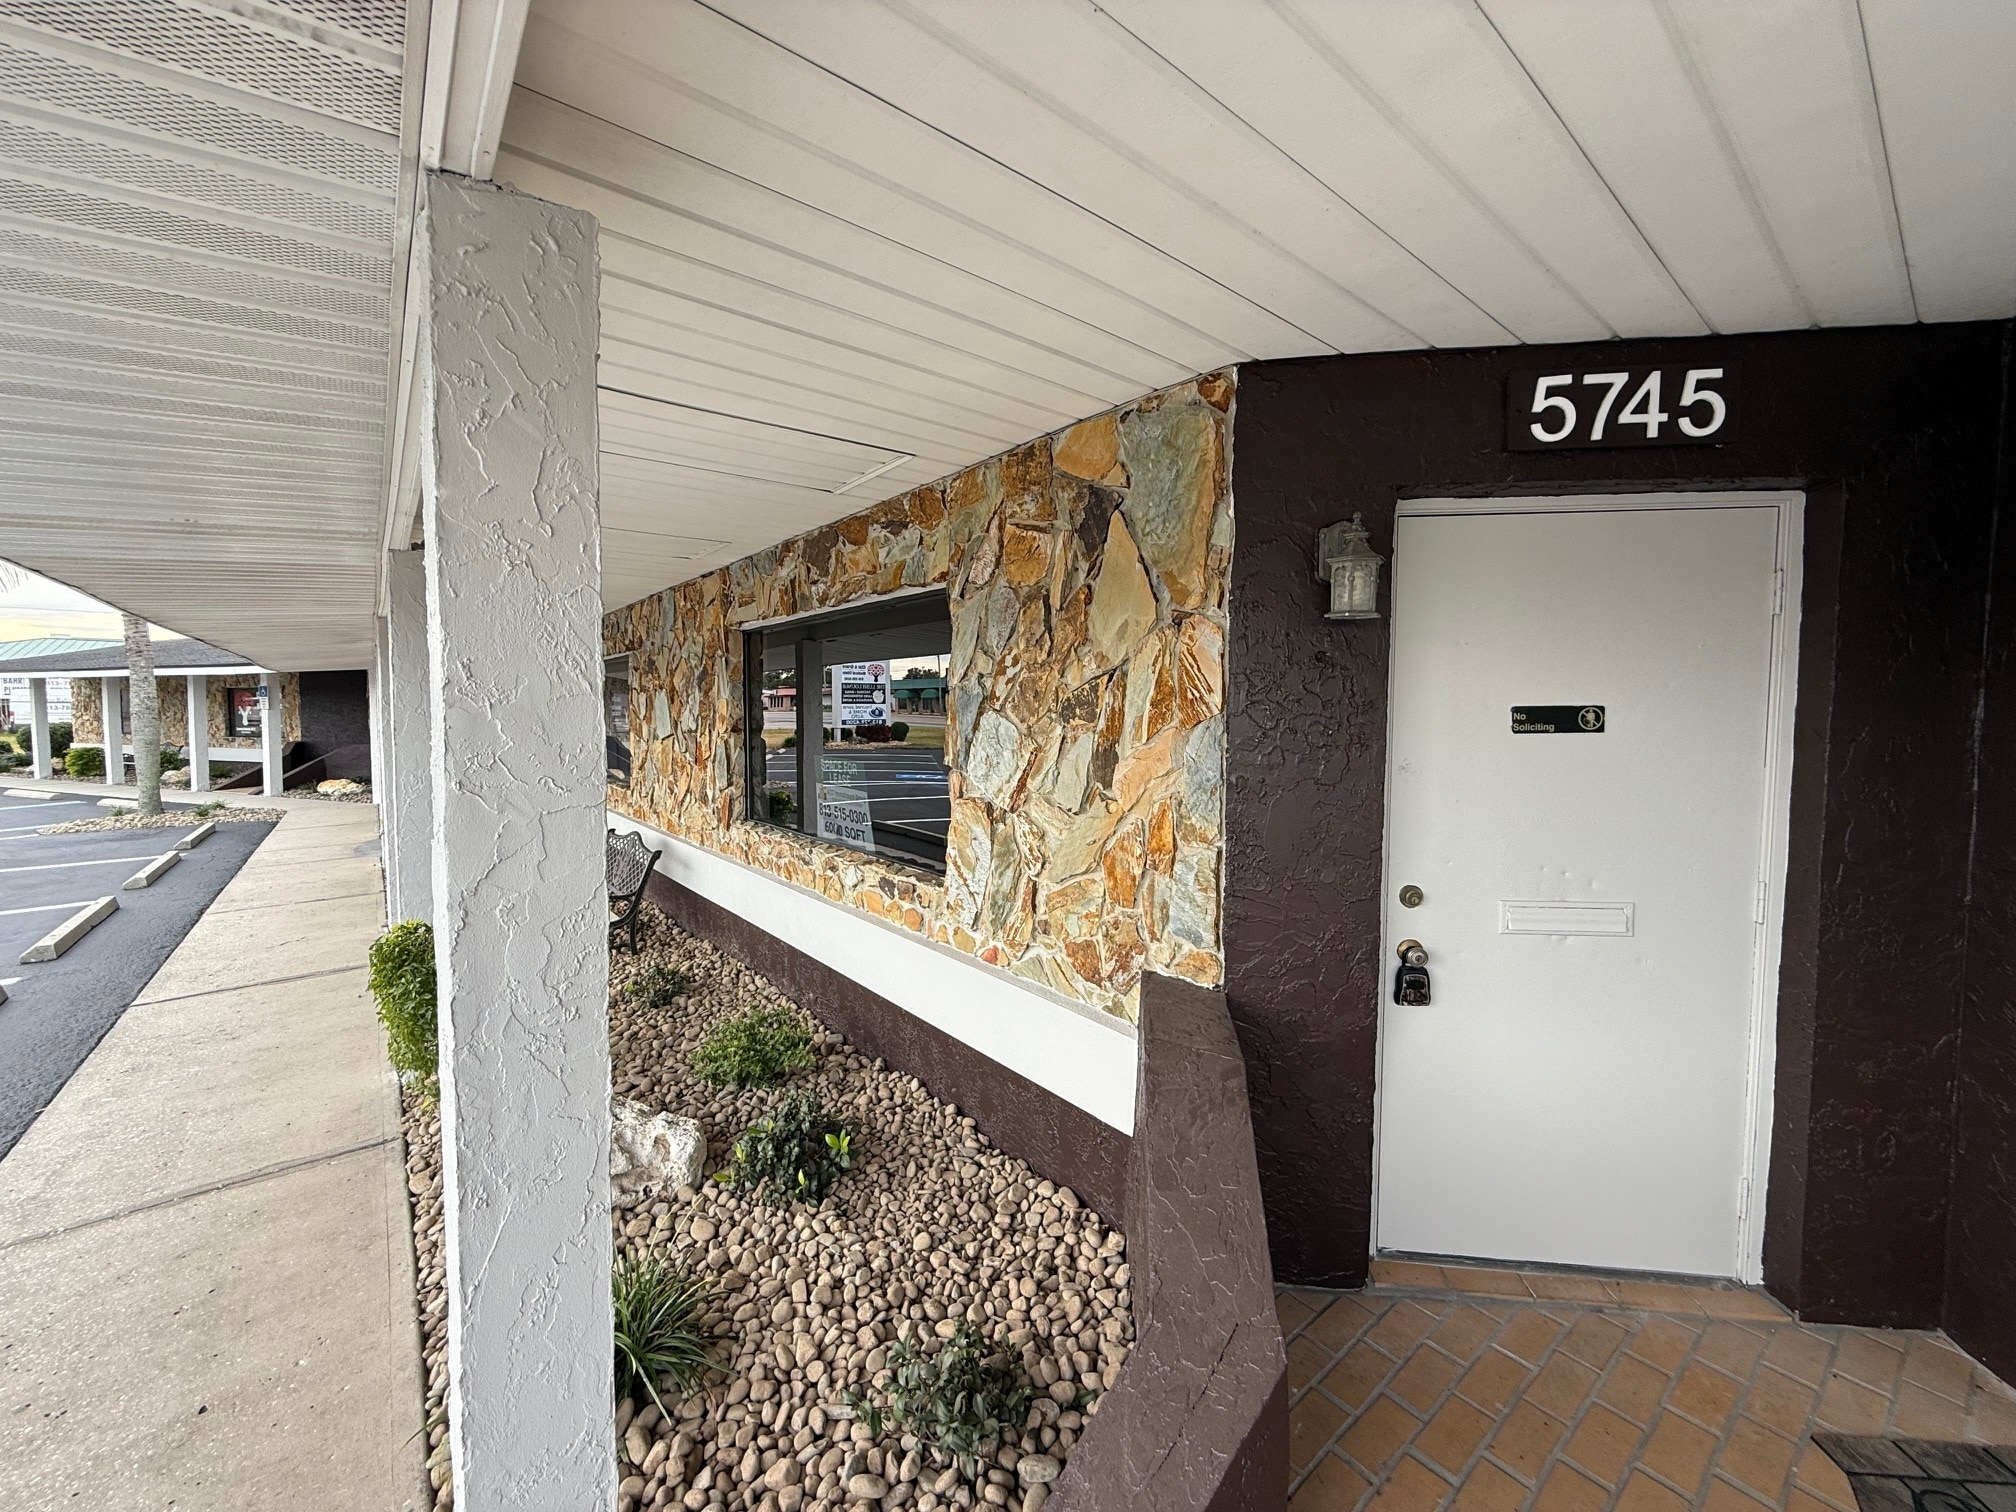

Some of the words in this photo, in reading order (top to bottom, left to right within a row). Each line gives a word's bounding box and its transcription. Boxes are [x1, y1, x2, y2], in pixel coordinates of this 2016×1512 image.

[1530, 368, 1726, 442] 5745
[1513, 712, 1526, 720] No
[1513, 723, 1554, 732] Soliciting
[821, 759, 843, 773] SPACE
[843, 761, 858, 776] FOR
[829, 773, 852, 787] LEASE
[818, 802, 869, 827] 813-515-0300
[844, 825, 866, 843] SQFT
